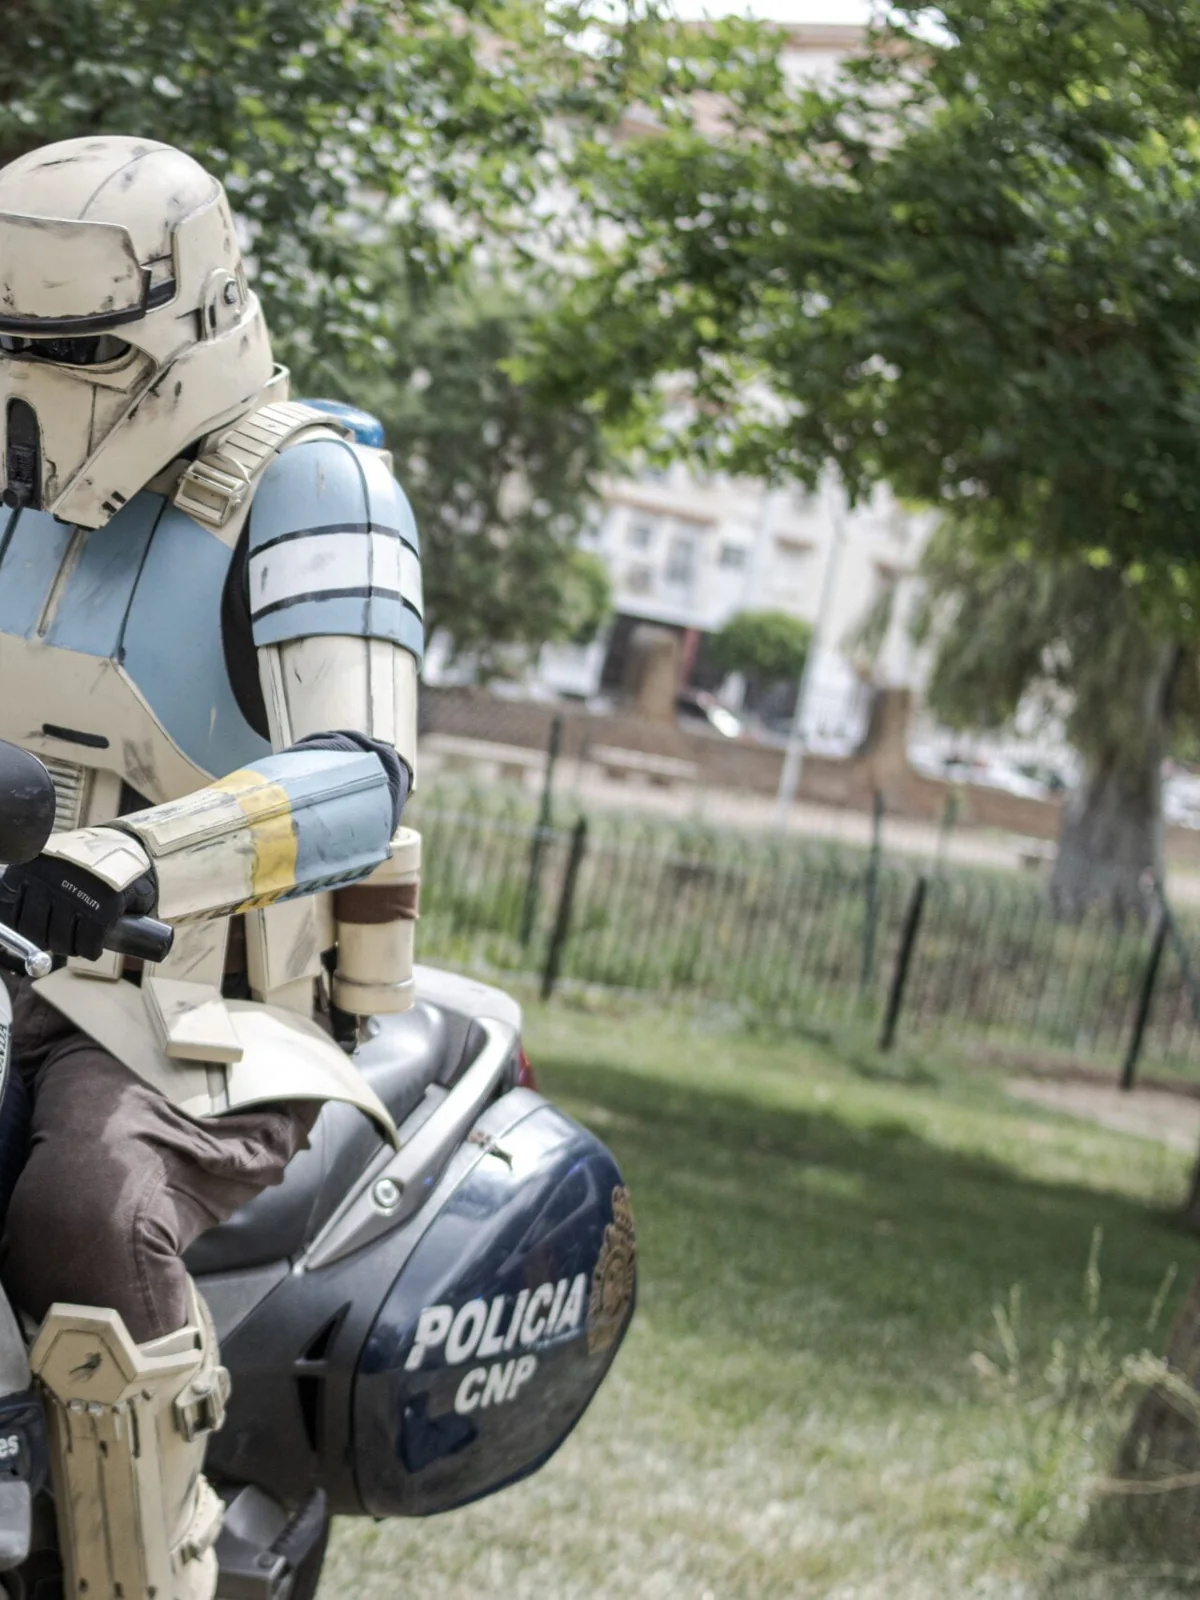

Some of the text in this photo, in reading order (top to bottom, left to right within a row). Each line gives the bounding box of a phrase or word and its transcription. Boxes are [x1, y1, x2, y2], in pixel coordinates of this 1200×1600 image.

[61, 880, 100, 910] CITY UTILITY
[404, 1272, 587, 1371] POLICIA
[454, 1354, 537, 1415] CNP
